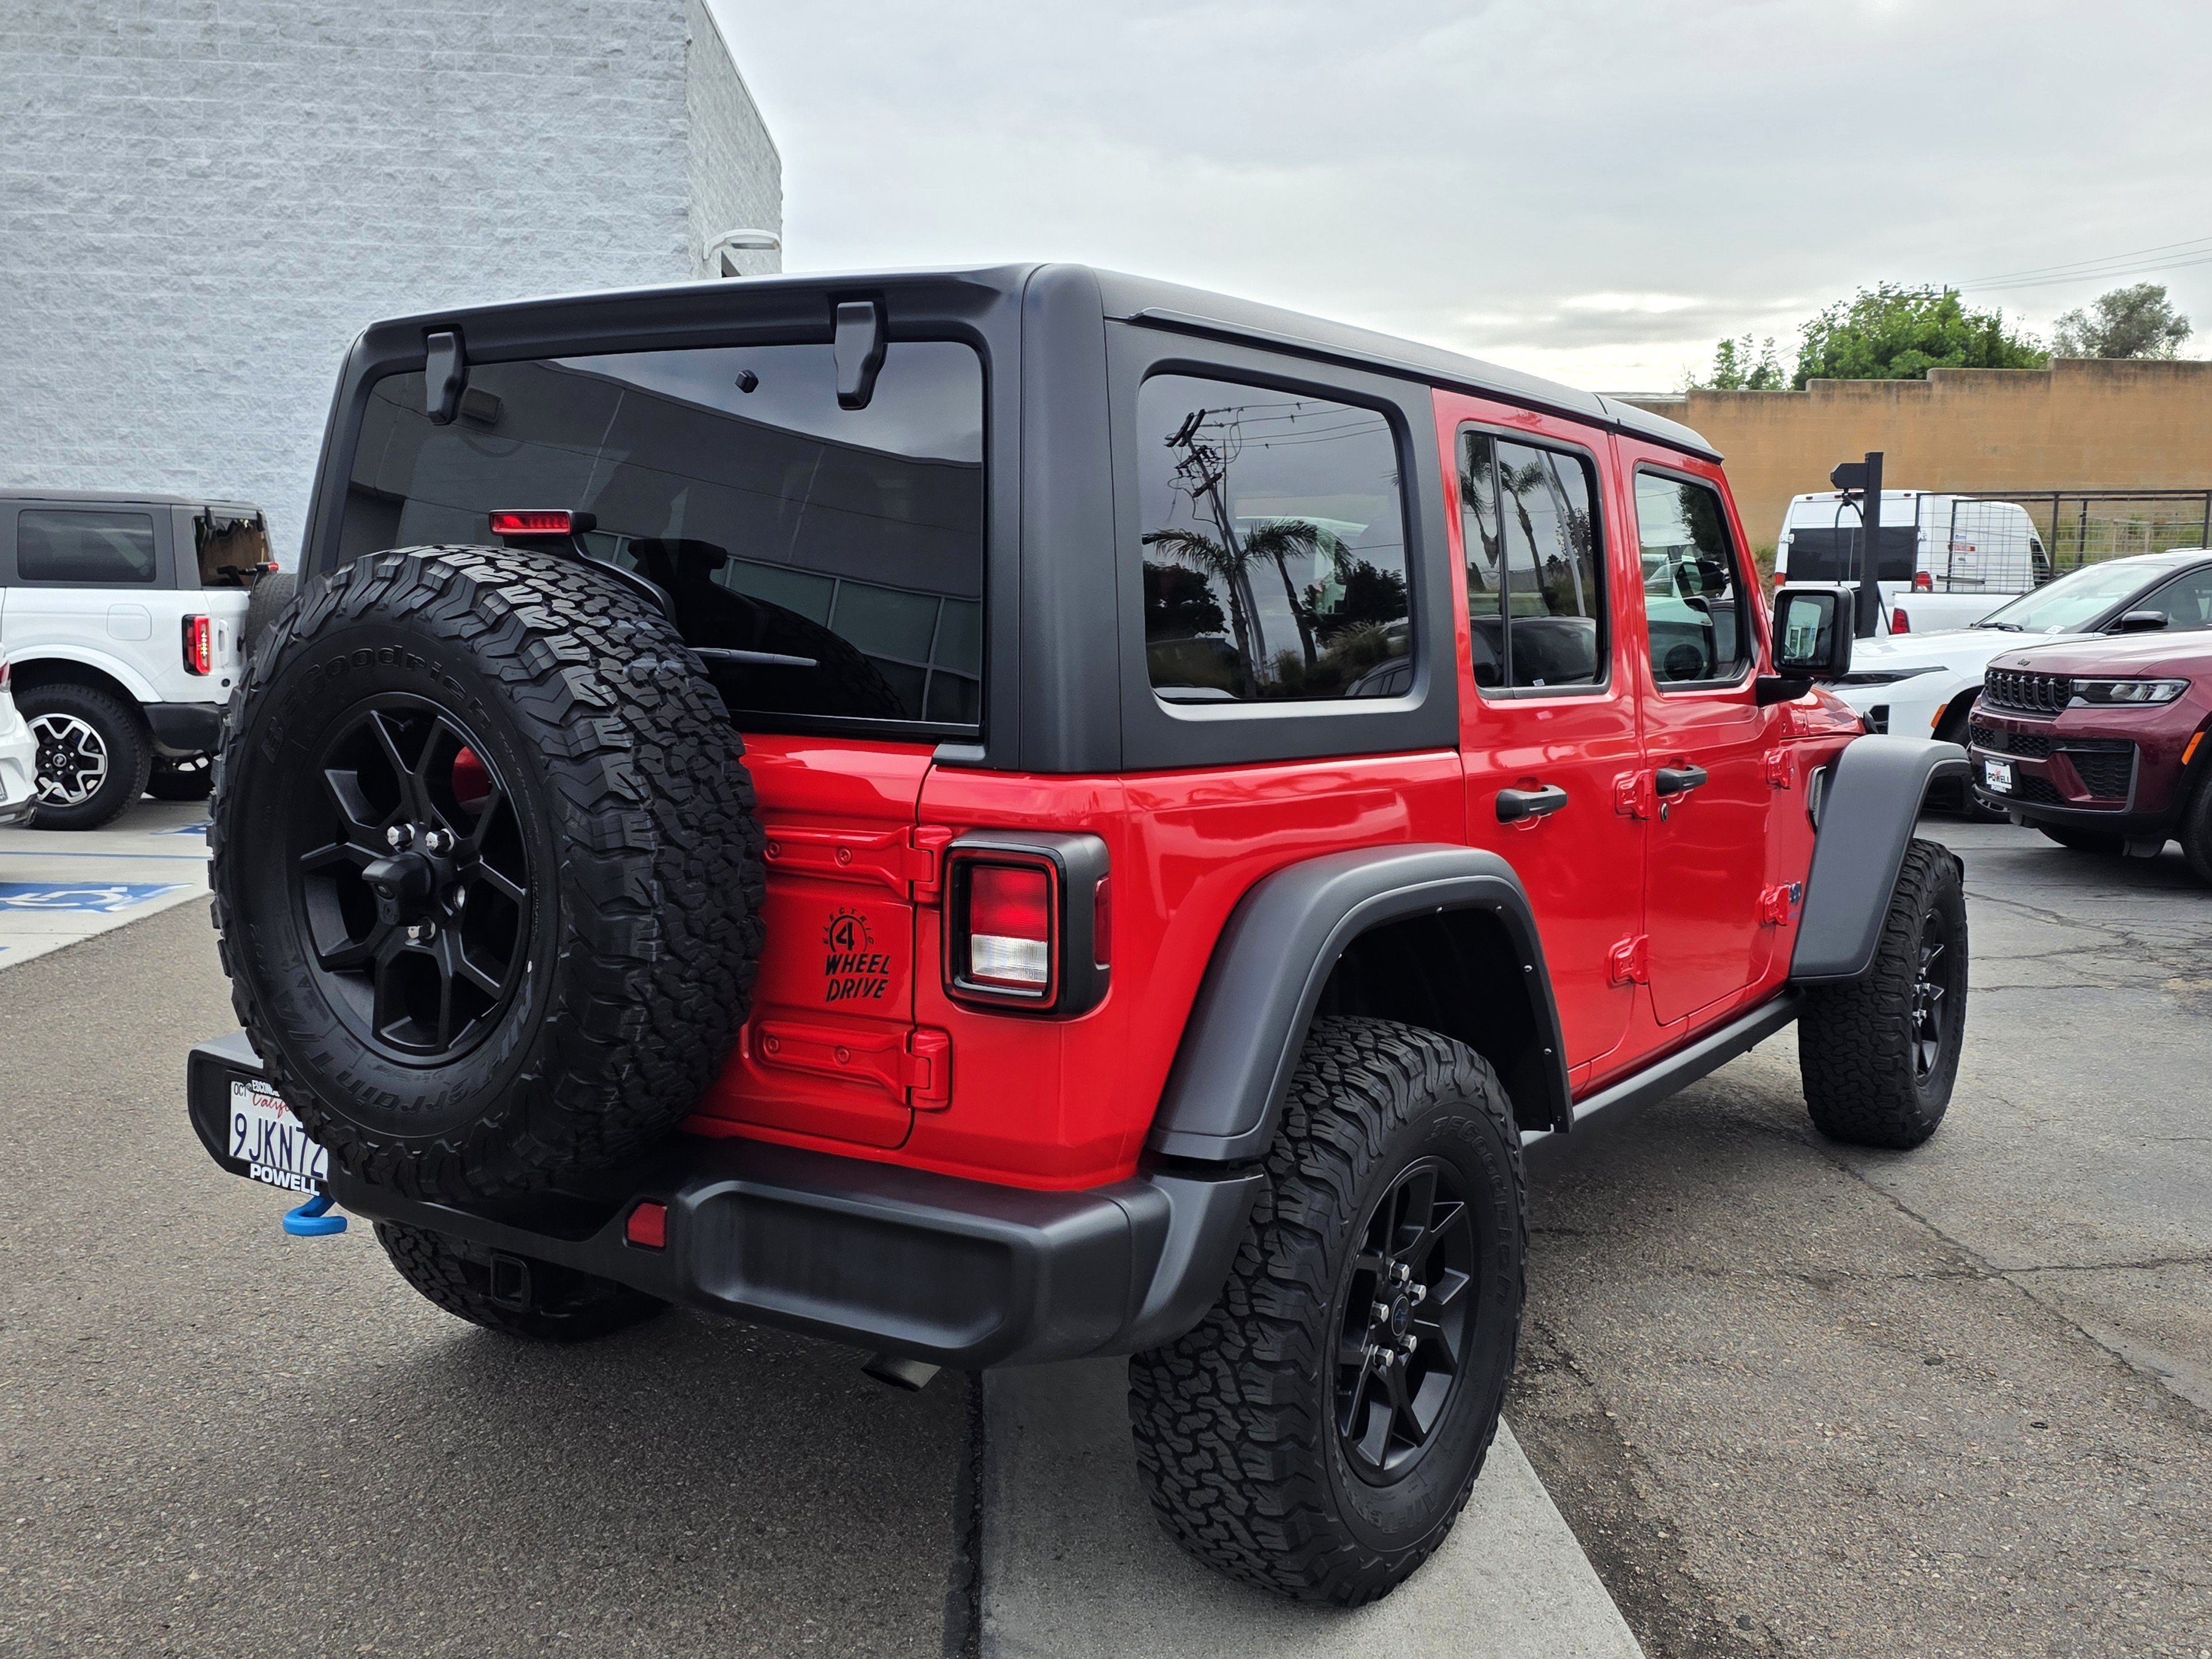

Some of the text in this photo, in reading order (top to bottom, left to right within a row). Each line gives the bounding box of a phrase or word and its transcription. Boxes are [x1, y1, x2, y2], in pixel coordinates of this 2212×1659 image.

[836, 922, 855, 951] 4
[825, 954, 892, 976] WHEEL
[825, 977, 890, 1003] DRIVE
[250, 1163, 320, 1196] POWELL
